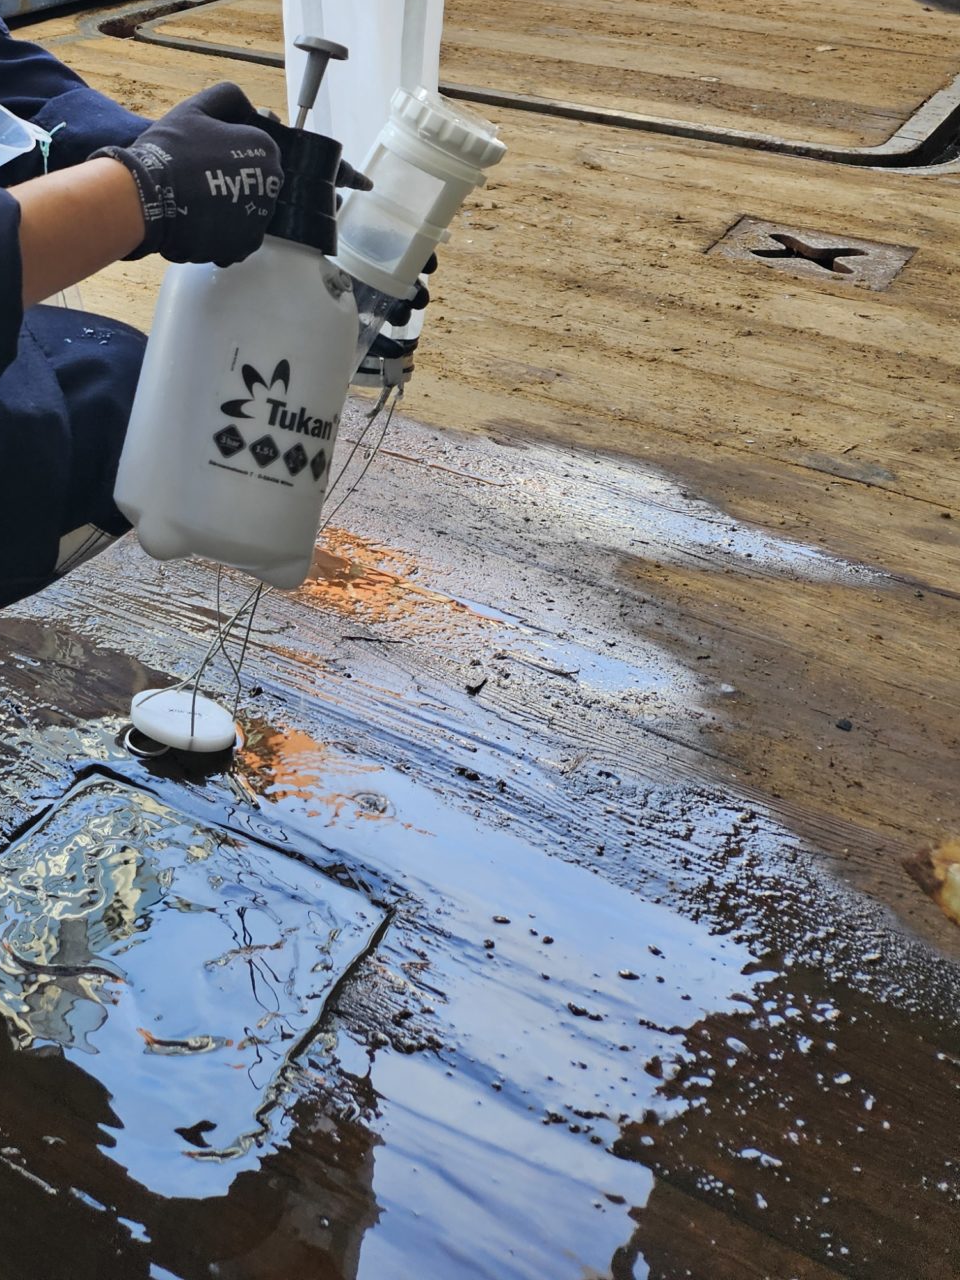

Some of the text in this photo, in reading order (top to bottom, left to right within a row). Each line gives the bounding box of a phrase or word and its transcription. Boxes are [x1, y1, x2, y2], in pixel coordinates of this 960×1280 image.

[230, 147, 267, 160] 11-840
[205, 167, 281, 204] HyFle
[266, 397, 333, 441] Tukan
